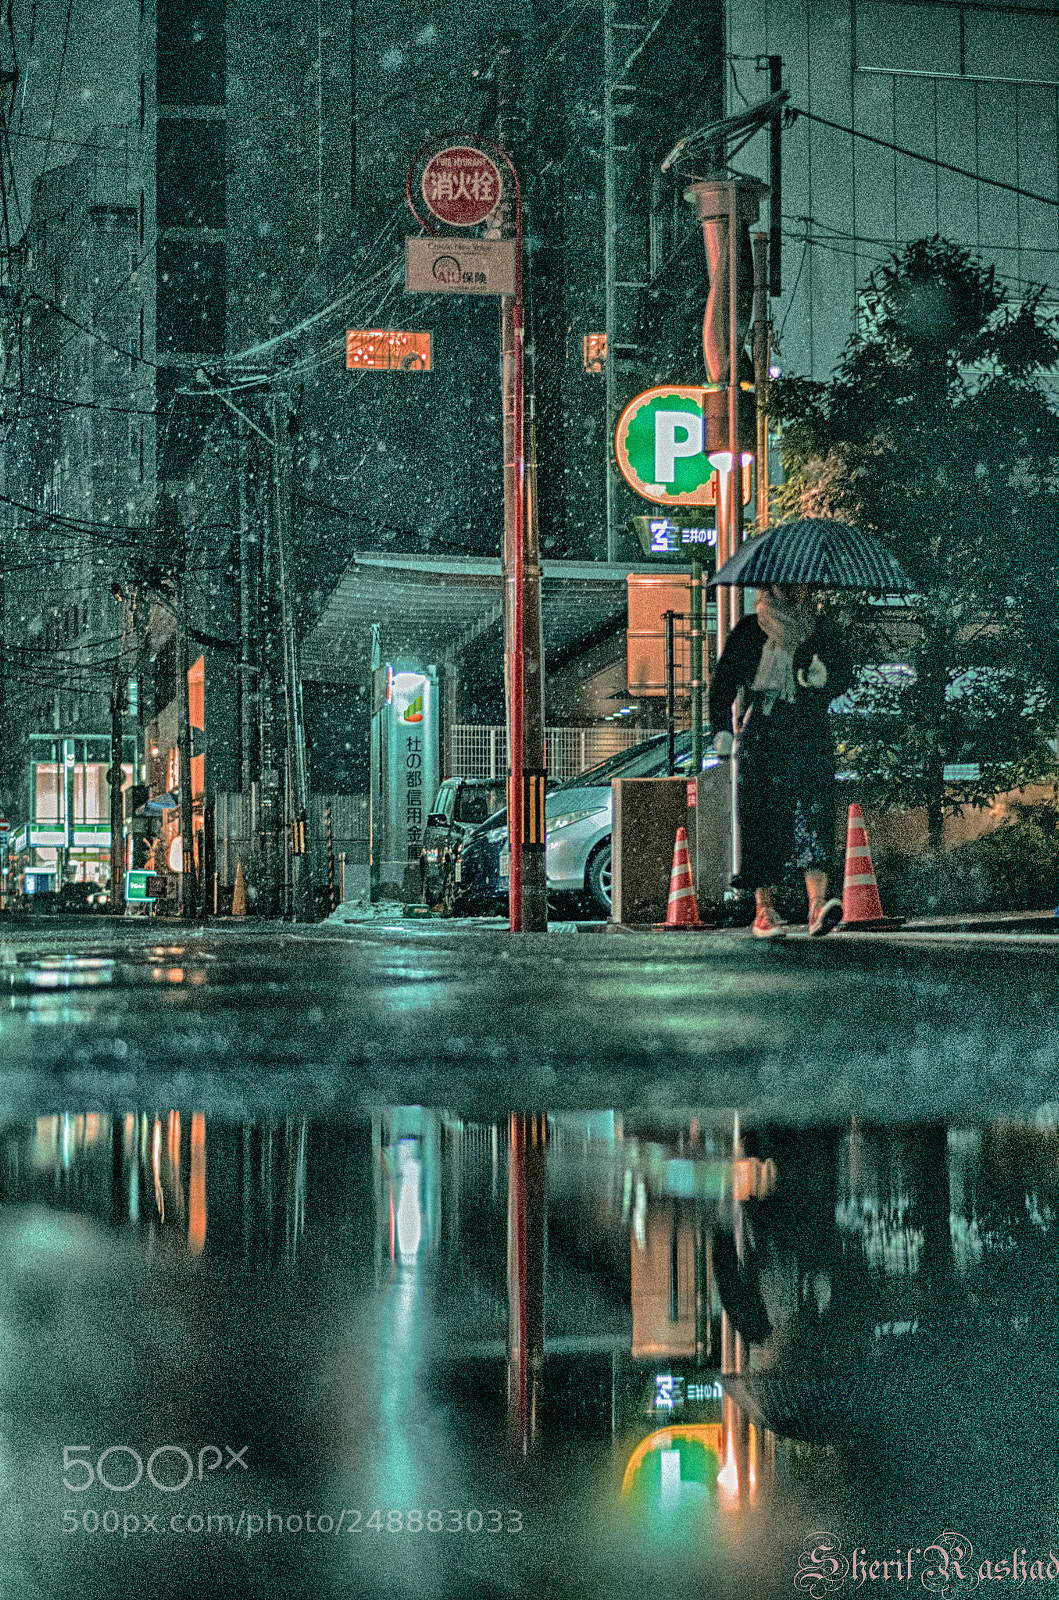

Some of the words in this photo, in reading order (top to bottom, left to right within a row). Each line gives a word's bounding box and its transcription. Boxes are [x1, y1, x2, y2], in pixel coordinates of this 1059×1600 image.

[431, 171, 494, 200] 消火栓
[655, 410, 703, 483] P
[406, 735, 422, 861] 杜の都信用金庫
